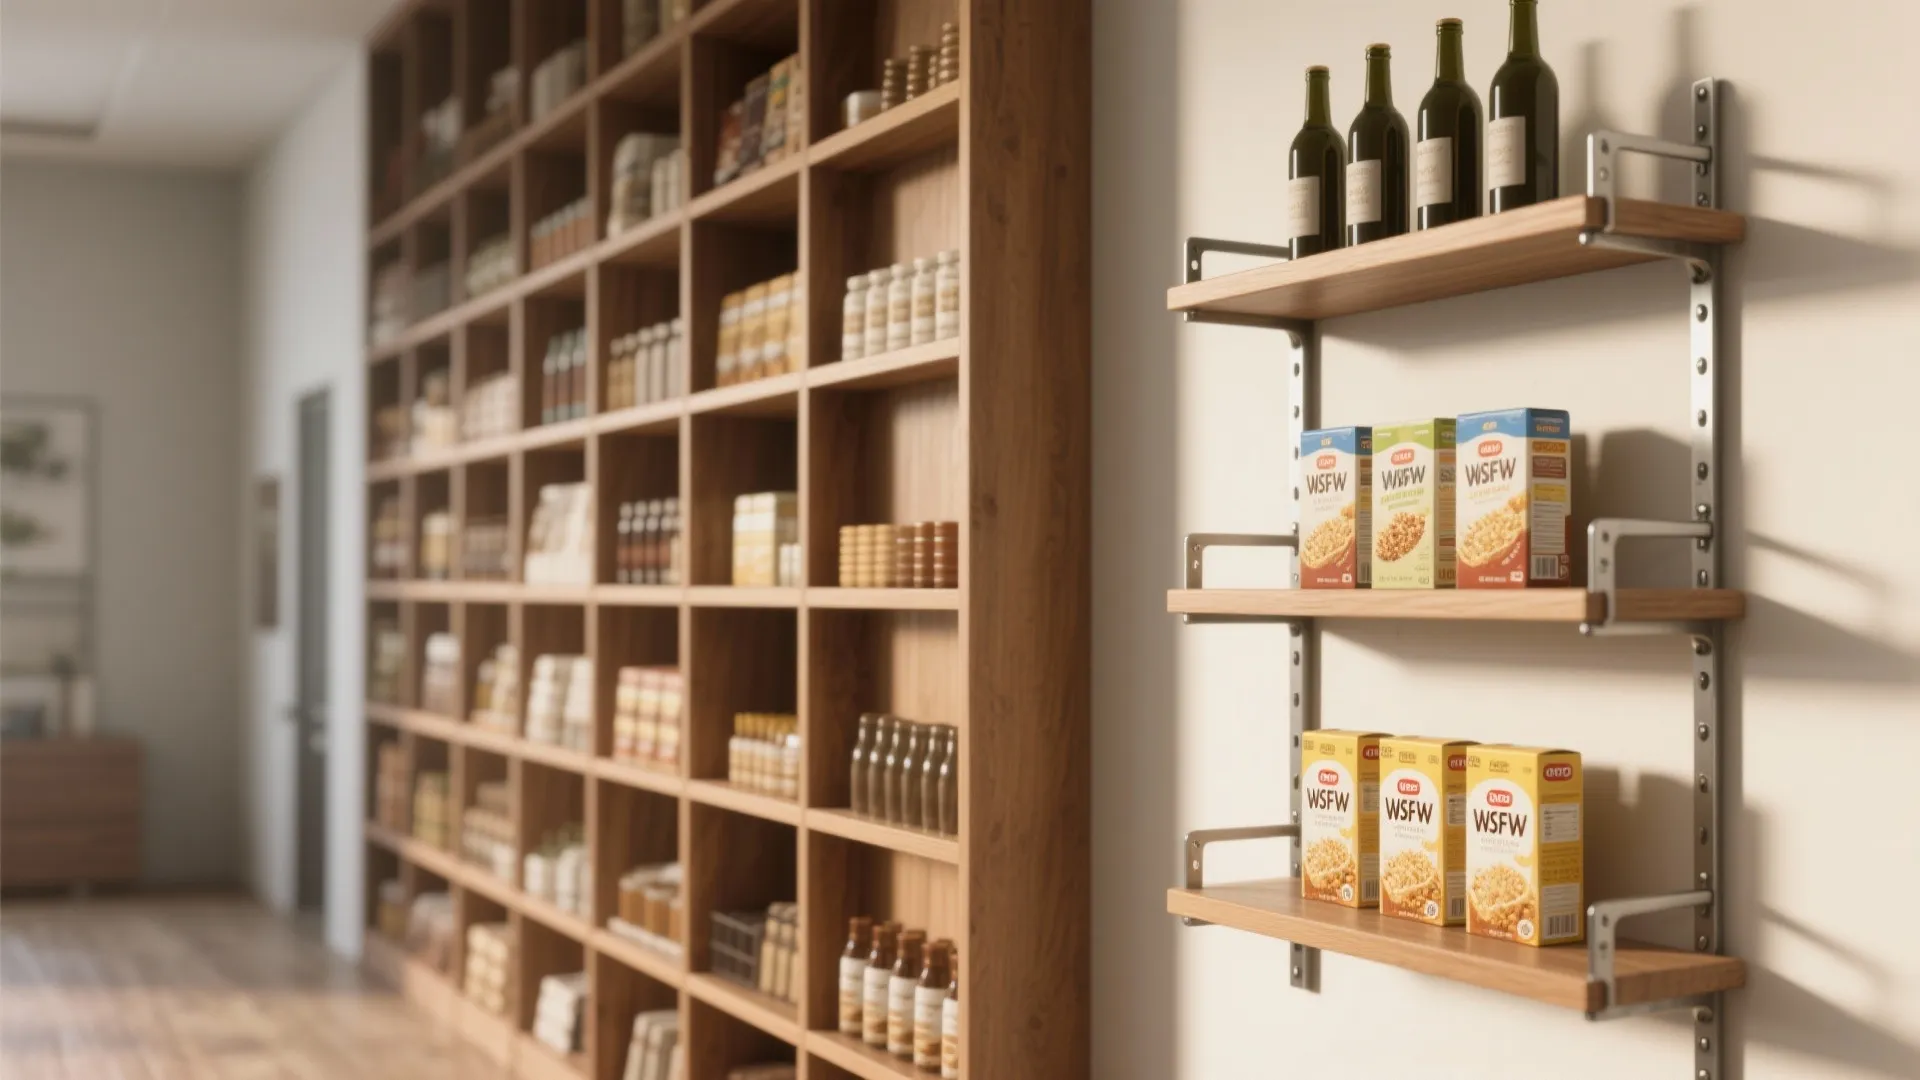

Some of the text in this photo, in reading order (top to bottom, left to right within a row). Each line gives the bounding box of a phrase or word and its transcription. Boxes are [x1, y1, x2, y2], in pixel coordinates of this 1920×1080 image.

[1307, 471, 1346, 494] WSFW
[1465, 458, 1516, 487] WSFW
[1307, 787, 1349, 814] WSFW
[1386, 797, 1433, 824] WSFW
[1474, 809, 1527, 837] WSFW
